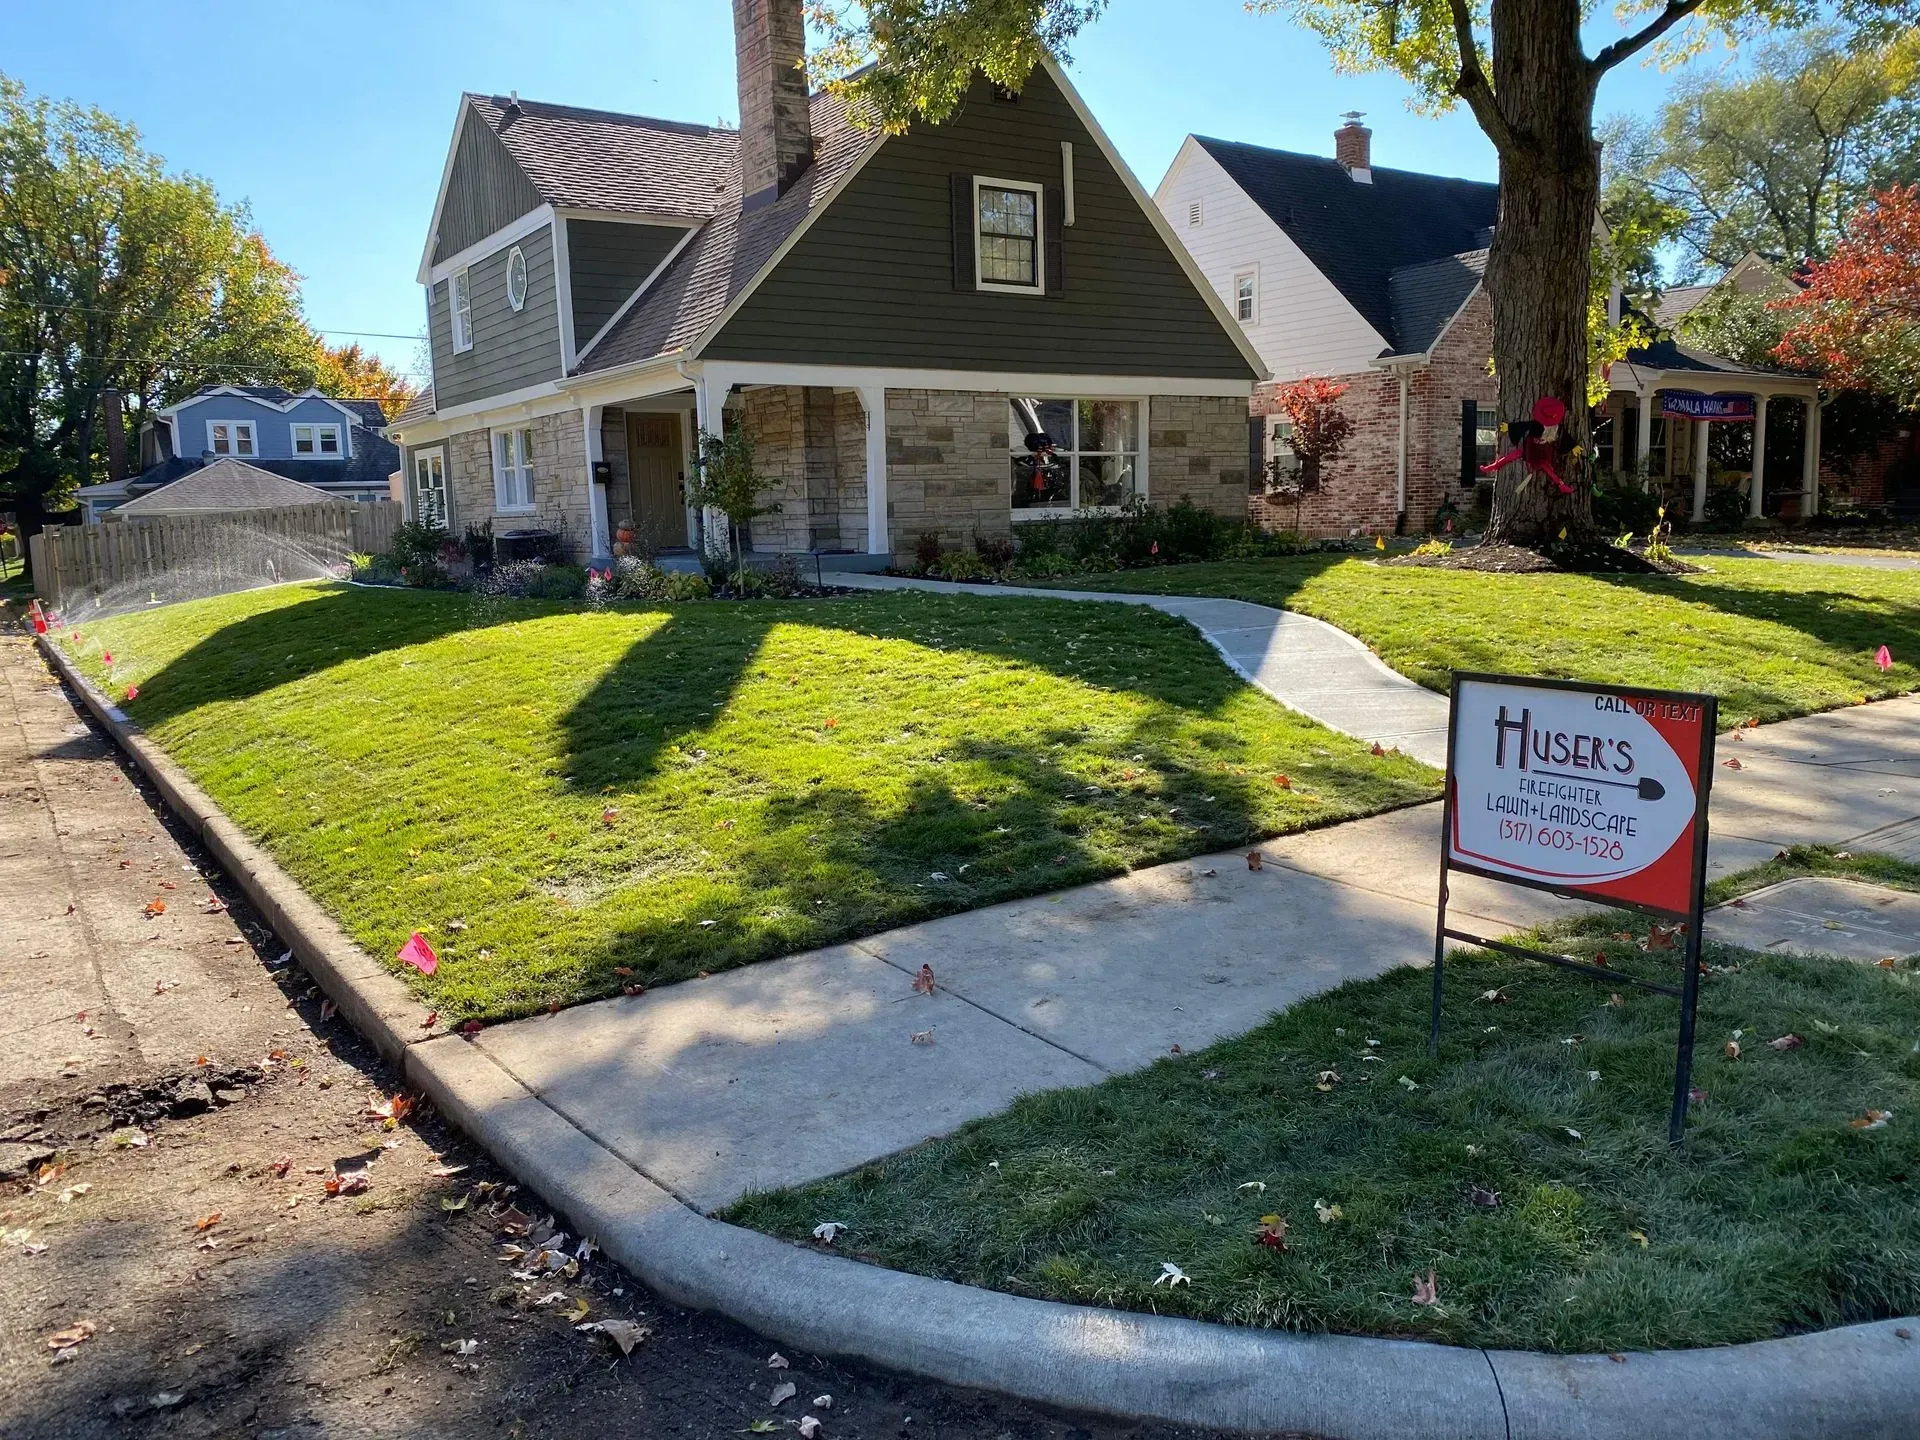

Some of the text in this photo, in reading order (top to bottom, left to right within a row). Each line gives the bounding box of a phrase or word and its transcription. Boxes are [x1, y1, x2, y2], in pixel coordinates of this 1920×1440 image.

[1594, 695, 1701, 723] CALL OR TEXT
[1494, 705, 1635, 775] HUSER'S
[1519, 778, 1603, 806] FIREFIGHTER
[1487, 793, 1638, 837] LAWN+LANDSCAPE
[1499, 818, 1624, 861] (317) 603-1528
